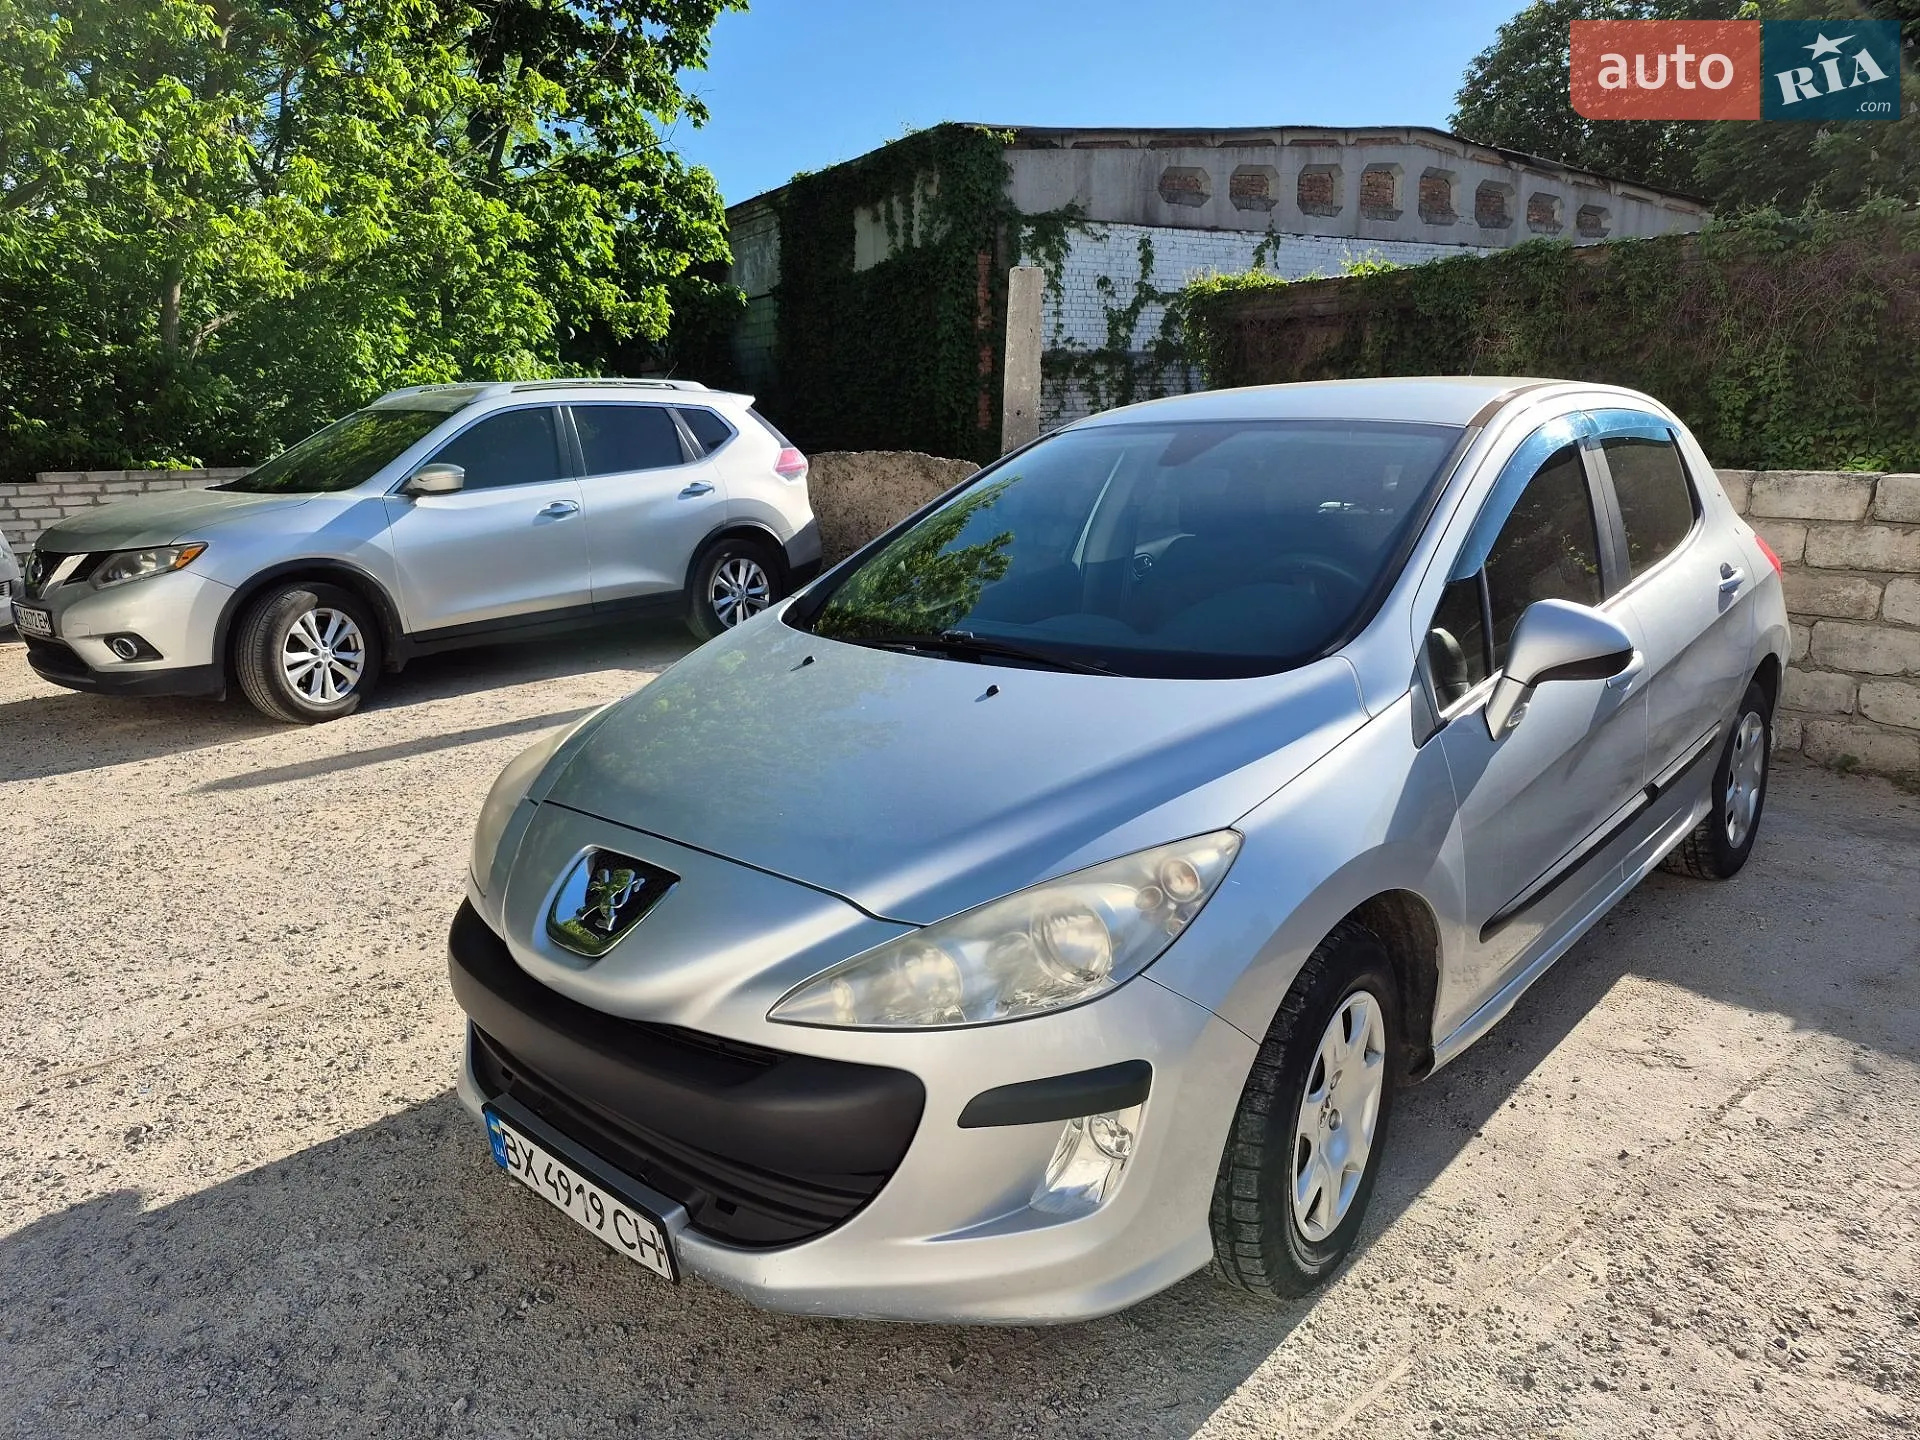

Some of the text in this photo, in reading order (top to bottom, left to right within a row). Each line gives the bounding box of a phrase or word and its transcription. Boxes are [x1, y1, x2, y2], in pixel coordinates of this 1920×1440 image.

[501, 1128, 663, 1268] BX 4919 CH
